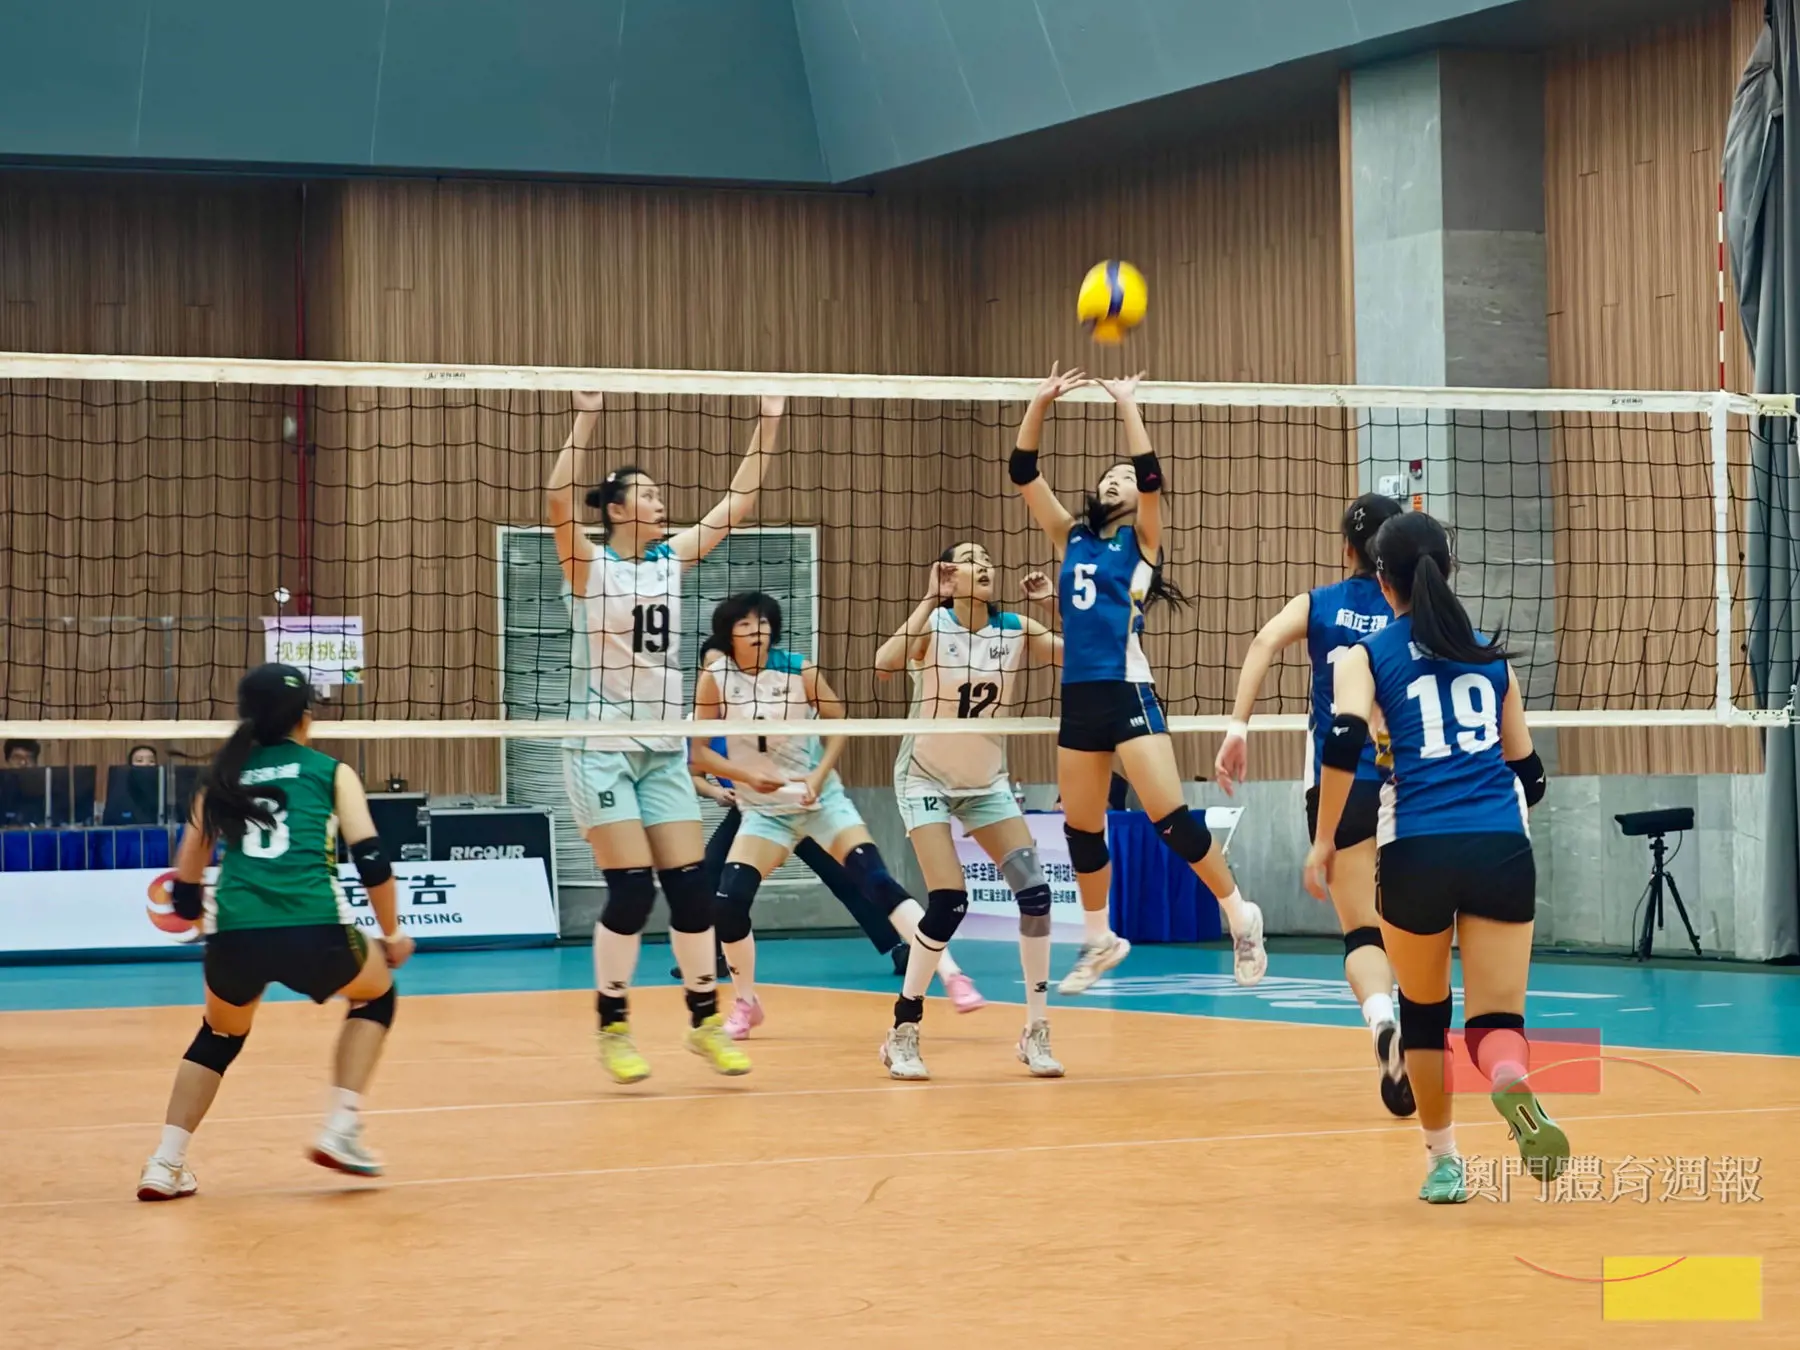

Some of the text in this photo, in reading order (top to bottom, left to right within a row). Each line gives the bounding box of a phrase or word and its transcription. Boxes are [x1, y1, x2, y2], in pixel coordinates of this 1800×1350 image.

[1071, 562, 1098, 611] 5
[632, 604, 670, 653] 19
[957, 682, 999, 719] 12
[1406, 672, 1501, 760] 19
[597, 790, 616, 809] 19
[923, 796, 940, 812] 12
[449, 844, 527, 861] RIGOUR
[354, 912, 463, 928] ADRTISING
